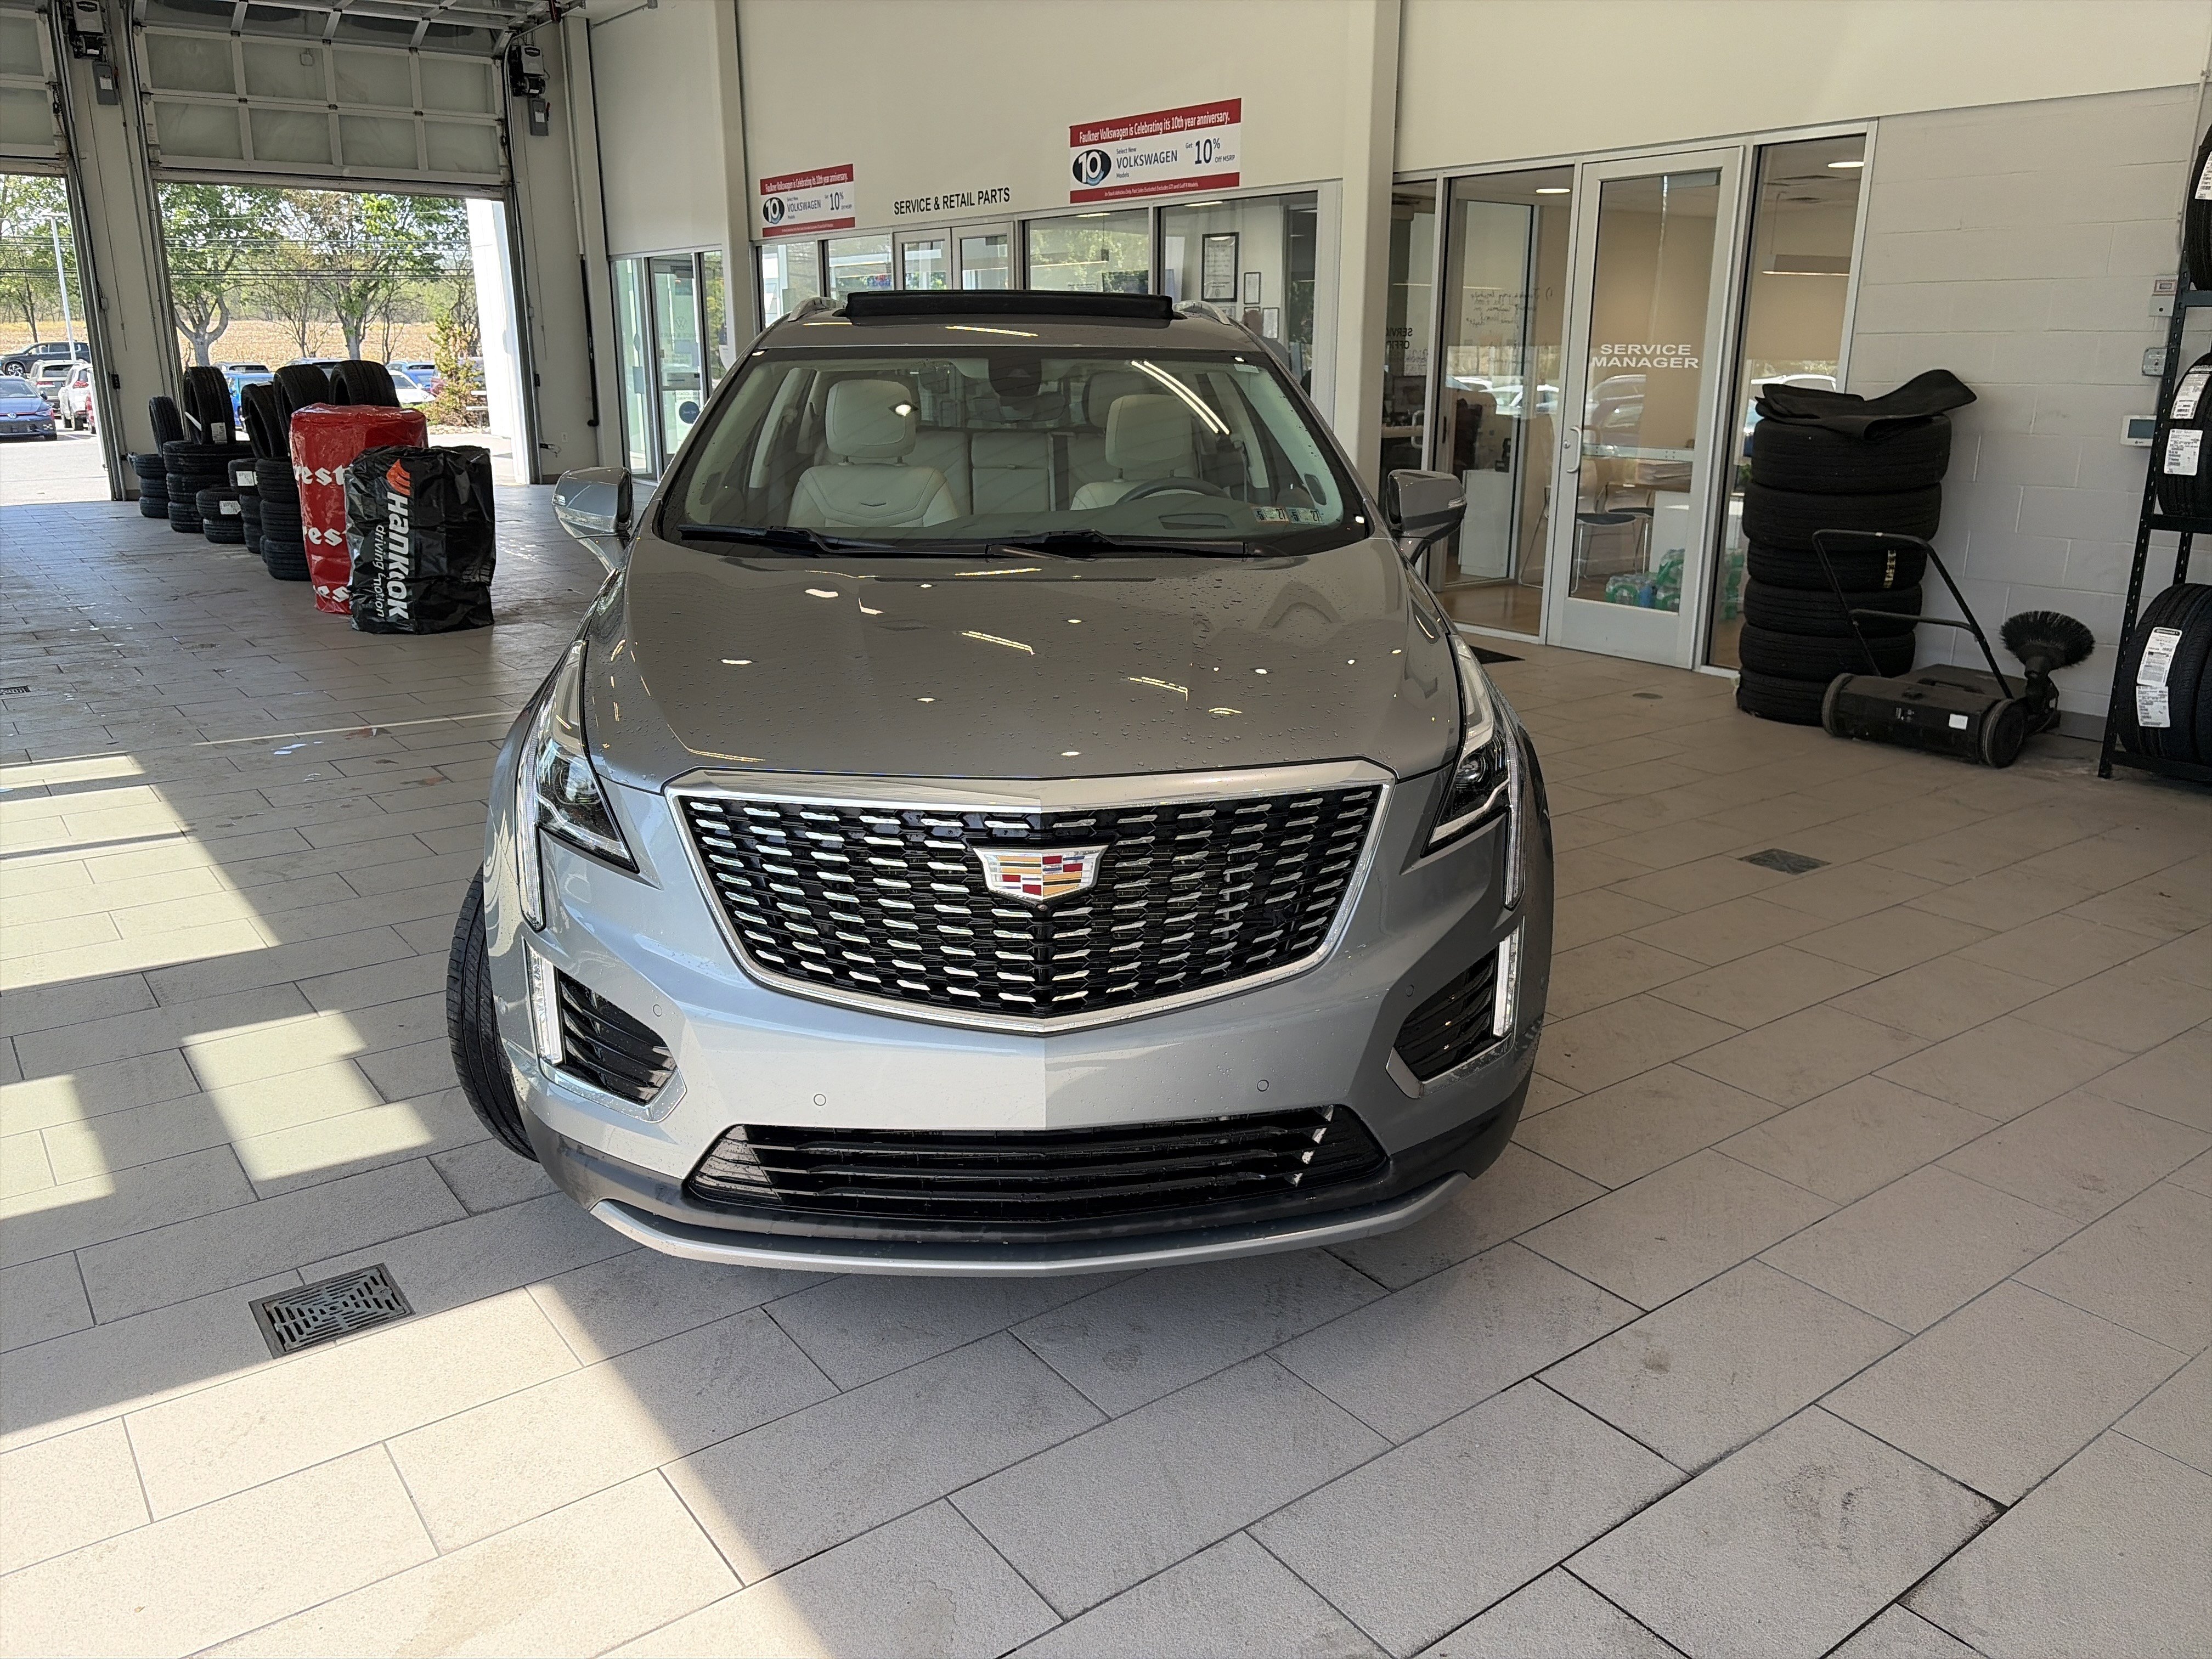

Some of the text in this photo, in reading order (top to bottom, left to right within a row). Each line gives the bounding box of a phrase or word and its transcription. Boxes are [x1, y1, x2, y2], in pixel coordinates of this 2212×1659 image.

[1079, 130, 1100, 143] Faulkner
[1099, 127, 1128, 140] Volkswagen
[1129, 123, 1133, 136] is
[1134, 120, 1163, 135] Celebrating
[1171, 116, 1184, 129] 10th
[1184, 116, 1197, 131] year
[1197, 111, 1230, 126] anniversary.
[1079, 151, 1102, 183] 10
[1116, 150, 1177, 169] VOLKSWAGEN
[765, 199, 780, 222] 10
[787, 199, 821, 212] VOLKSWAGEN
[894, 187, 1010, 215] SERVICE & RETAIL PARTS
[1600, 343, 1691, 356] SERVICE
[1591, 357, 1699, 369] MANAGER
[373, 524, 387, 571] driving
